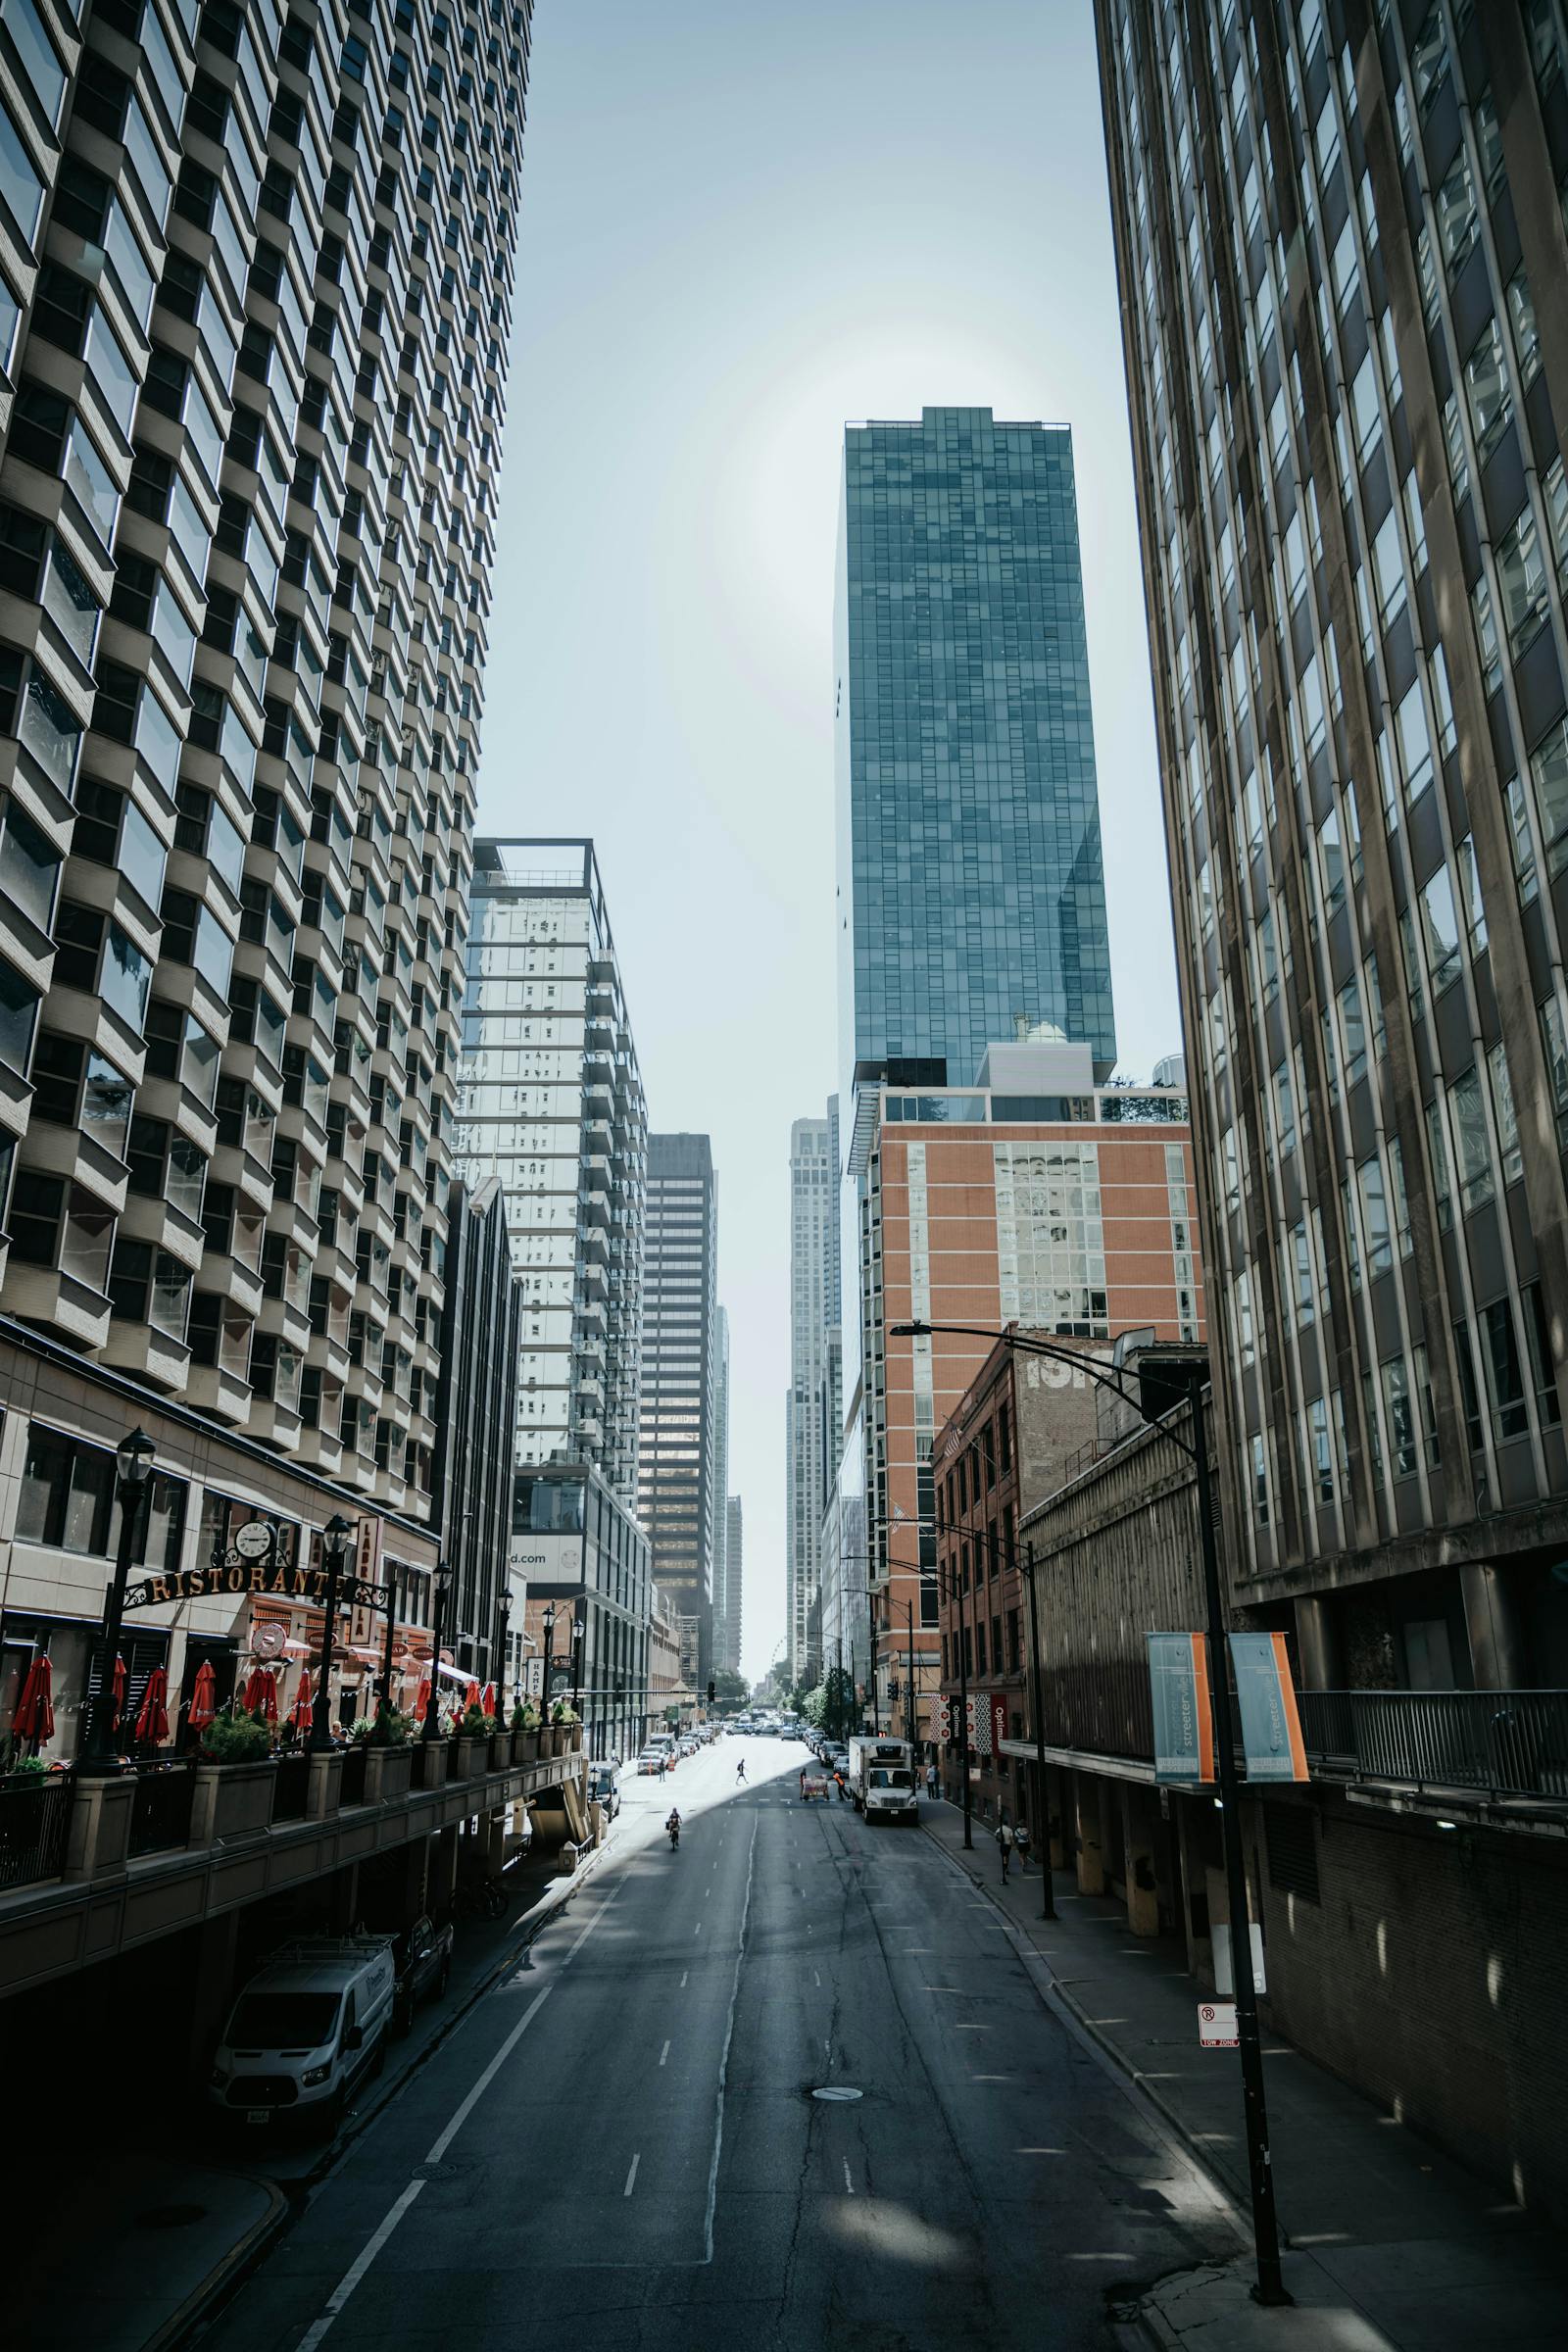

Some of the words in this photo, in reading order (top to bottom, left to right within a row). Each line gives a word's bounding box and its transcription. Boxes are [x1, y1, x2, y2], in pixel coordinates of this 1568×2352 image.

[356, 1524, 371, 1636] LABRLA
[952, 1705, 960, 1738] Optimus
[995, 1706, 1004, 1740] Optimu
